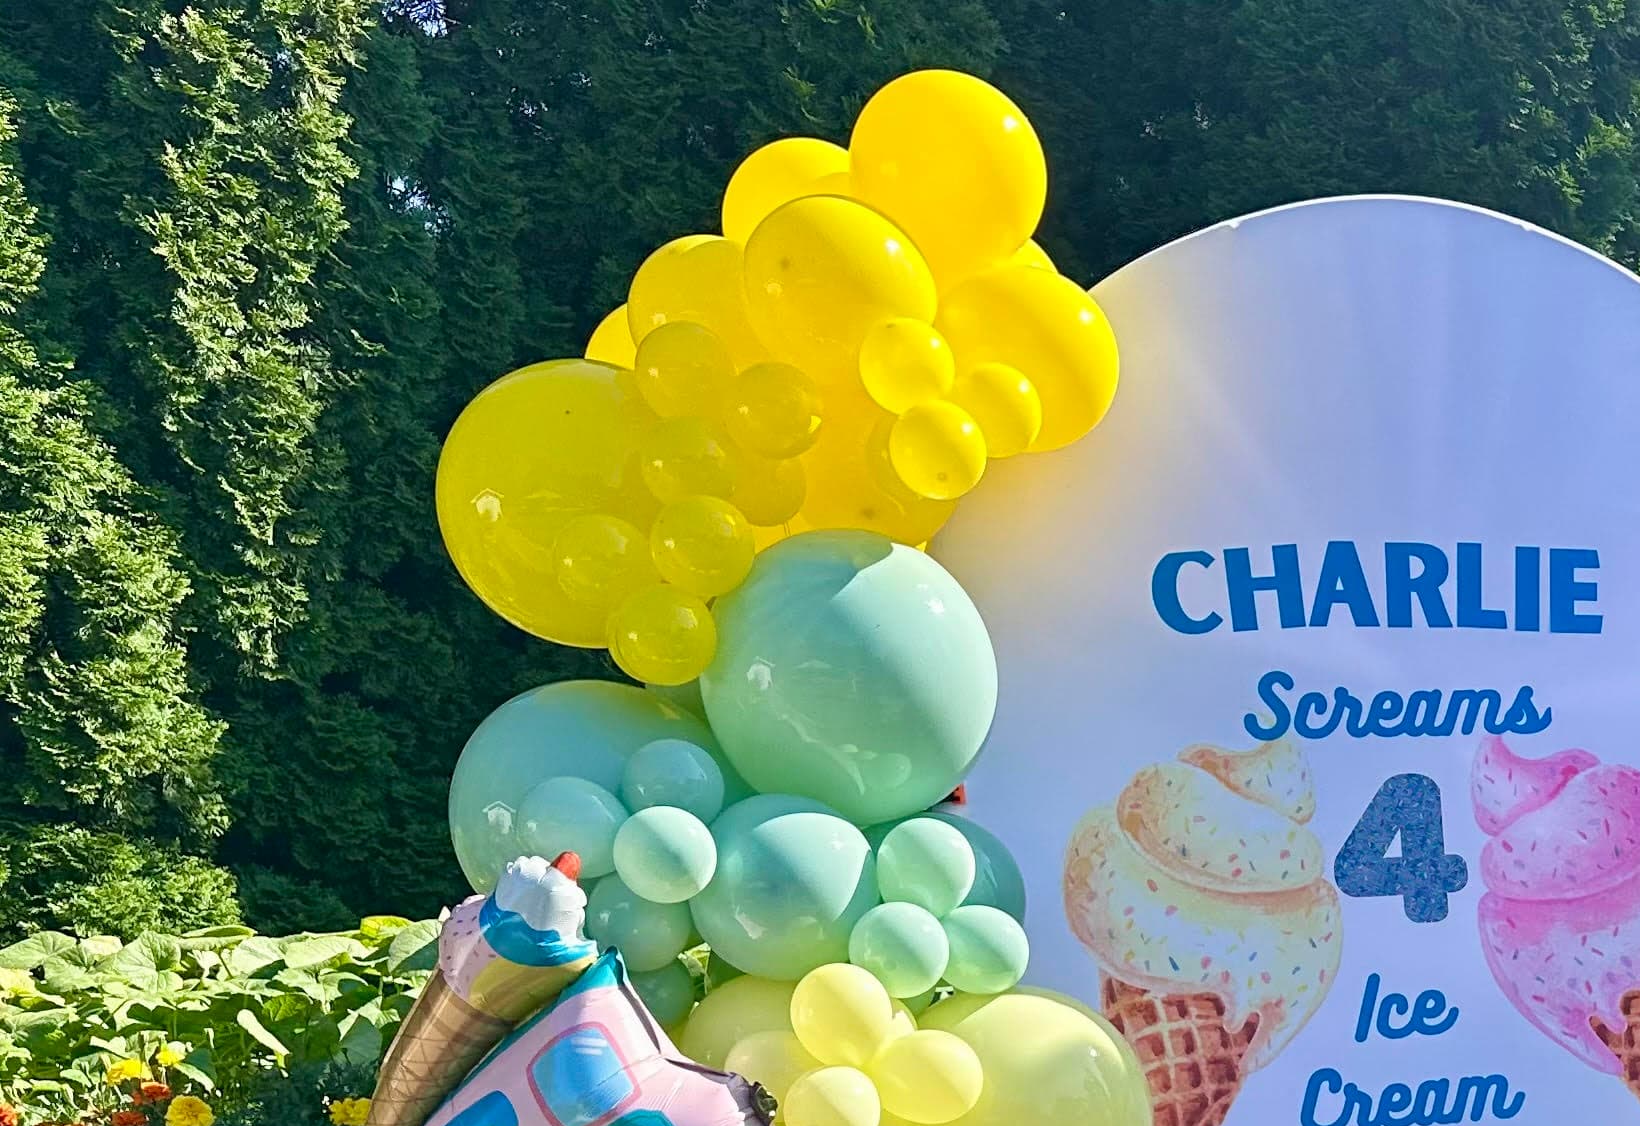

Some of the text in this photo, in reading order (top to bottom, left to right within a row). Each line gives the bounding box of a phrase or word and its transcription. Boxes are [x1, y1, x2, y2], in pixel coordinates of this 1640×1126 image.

[1151, 540, 1604, 635] CHARLIE
[1243, 670, 1553, 742] Screams
[1333, 773, 1469, 924] 4
[1354, 972, 1460, 1043] Ice
